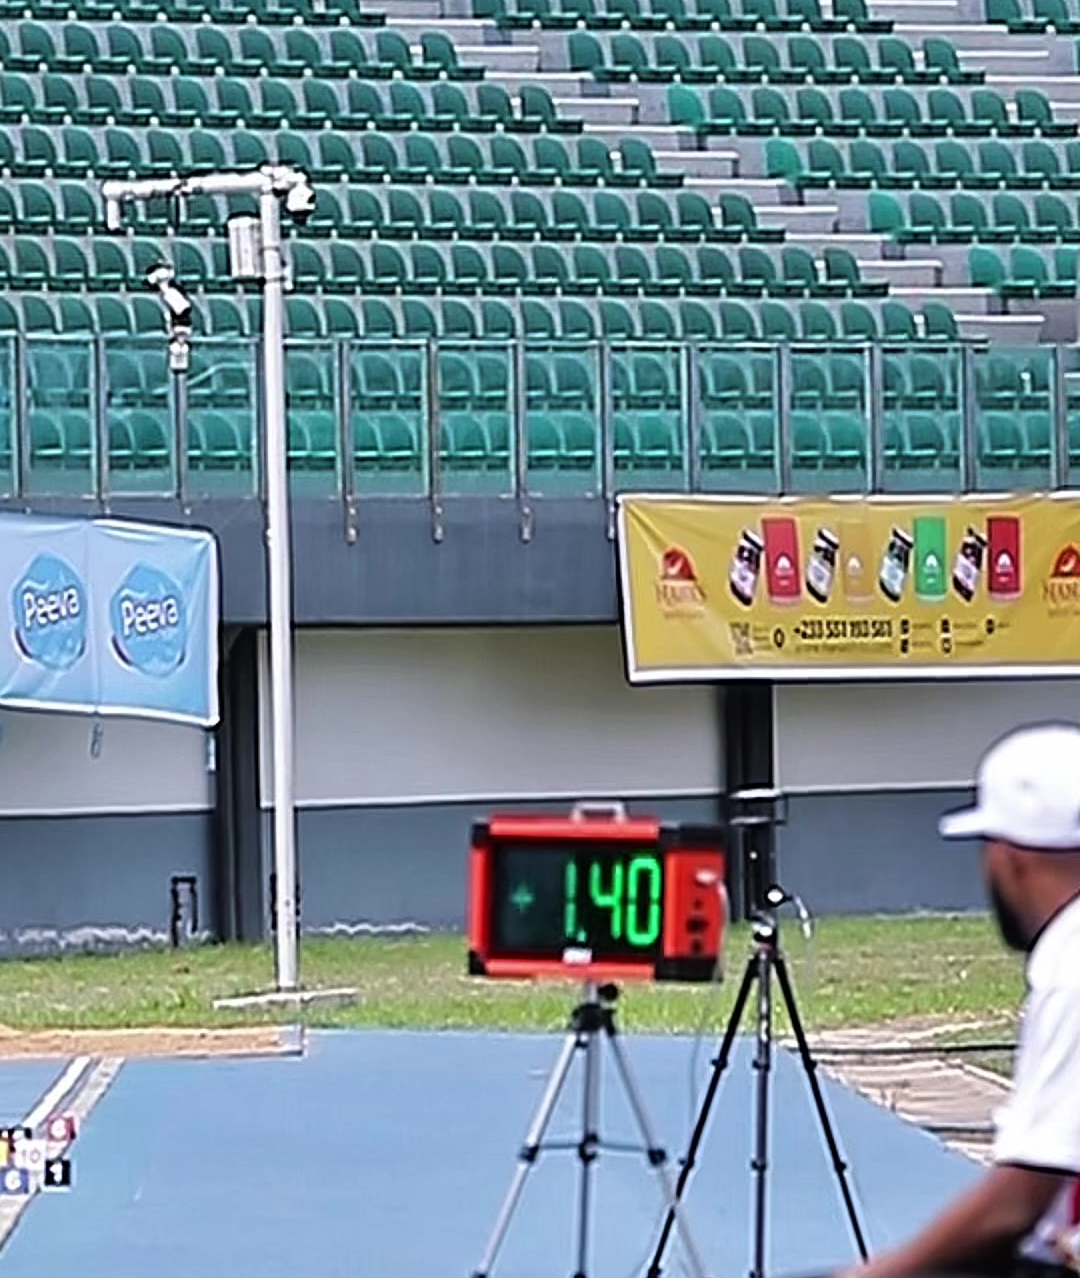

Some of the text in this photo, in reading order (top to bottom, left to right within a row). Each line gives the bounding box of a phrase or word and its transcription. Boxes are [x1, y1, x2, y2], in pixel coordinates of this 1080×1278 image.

[23, 587, 81, 628] Peeva
[122, 596, 179, 636] Peeva
[564, 855, 661, 946] 1.40
[4, 1169, 22, 1191] 6
[49, 1162, 63, 1183] 1
